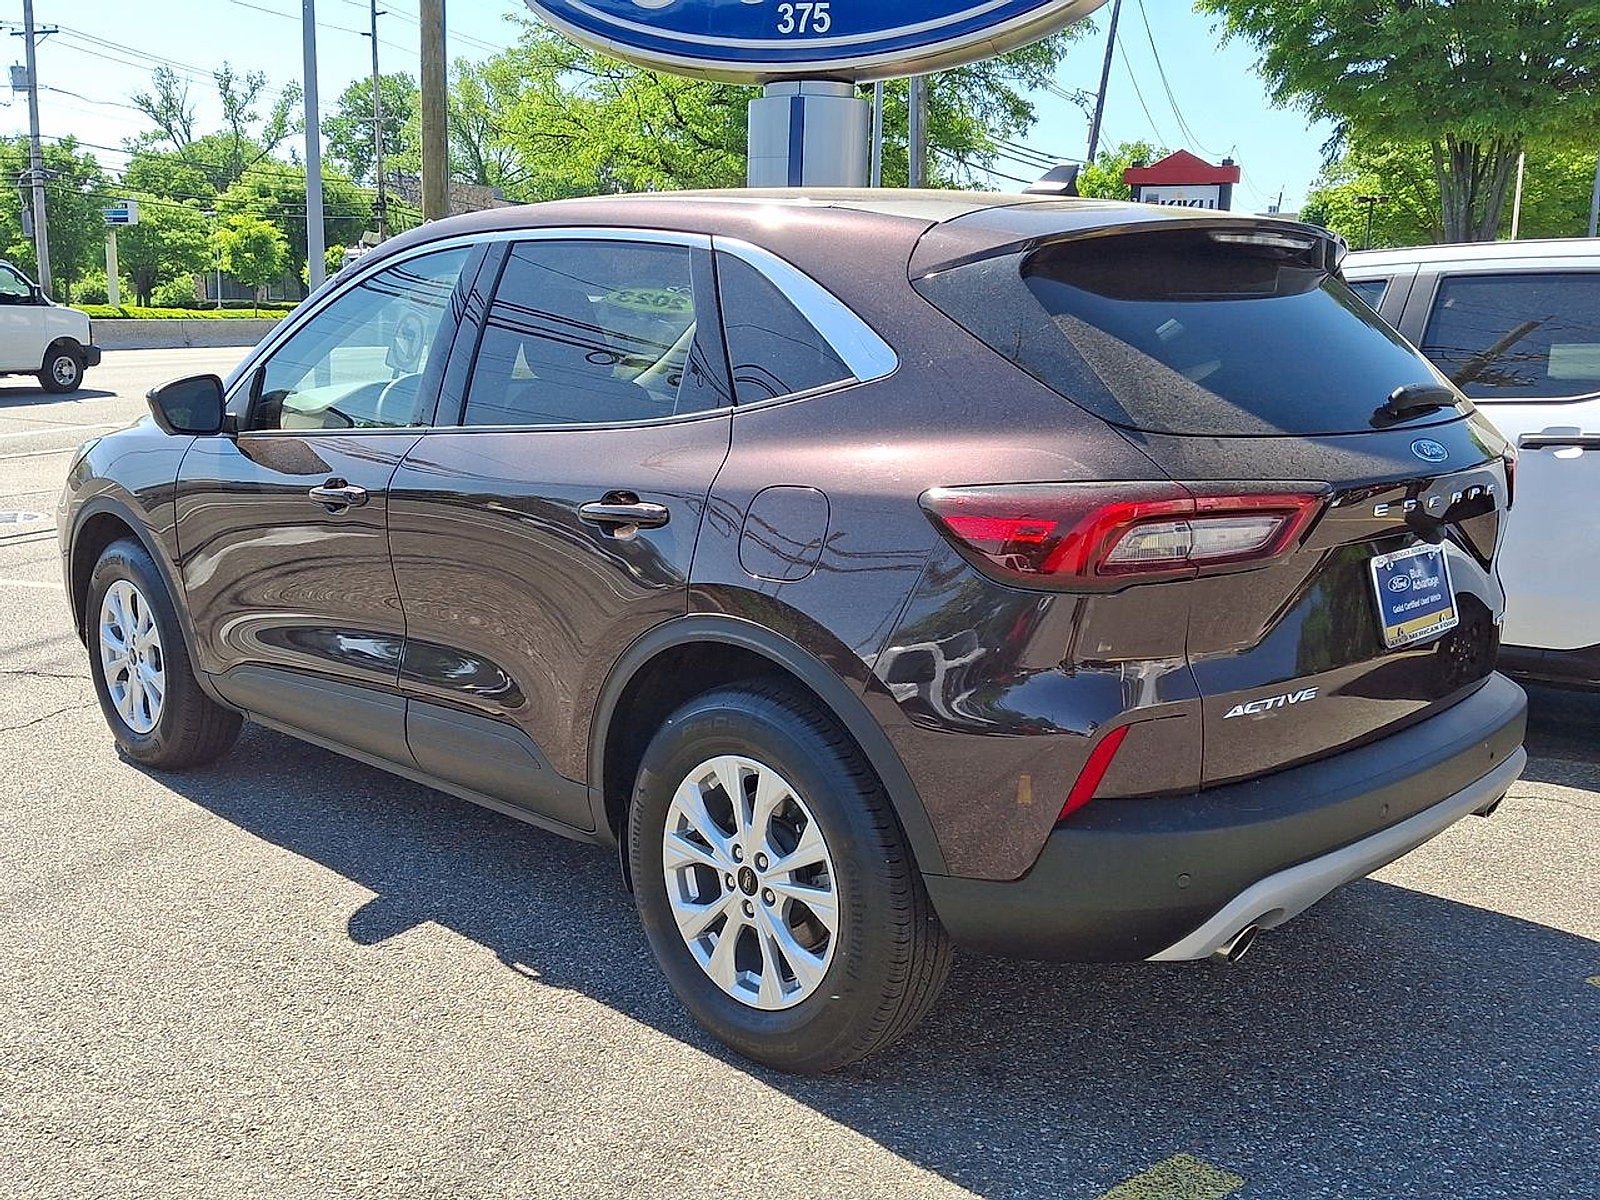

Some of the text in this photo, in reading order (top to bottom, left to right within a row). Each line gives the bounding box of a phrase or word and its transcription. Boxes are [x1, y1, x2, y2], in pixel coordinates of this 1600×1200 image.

[777, 2, 831, 34] 375
[1390, 576, 1409, 590] Ford
[1223, 686, 1320, 719] ACTIVE
